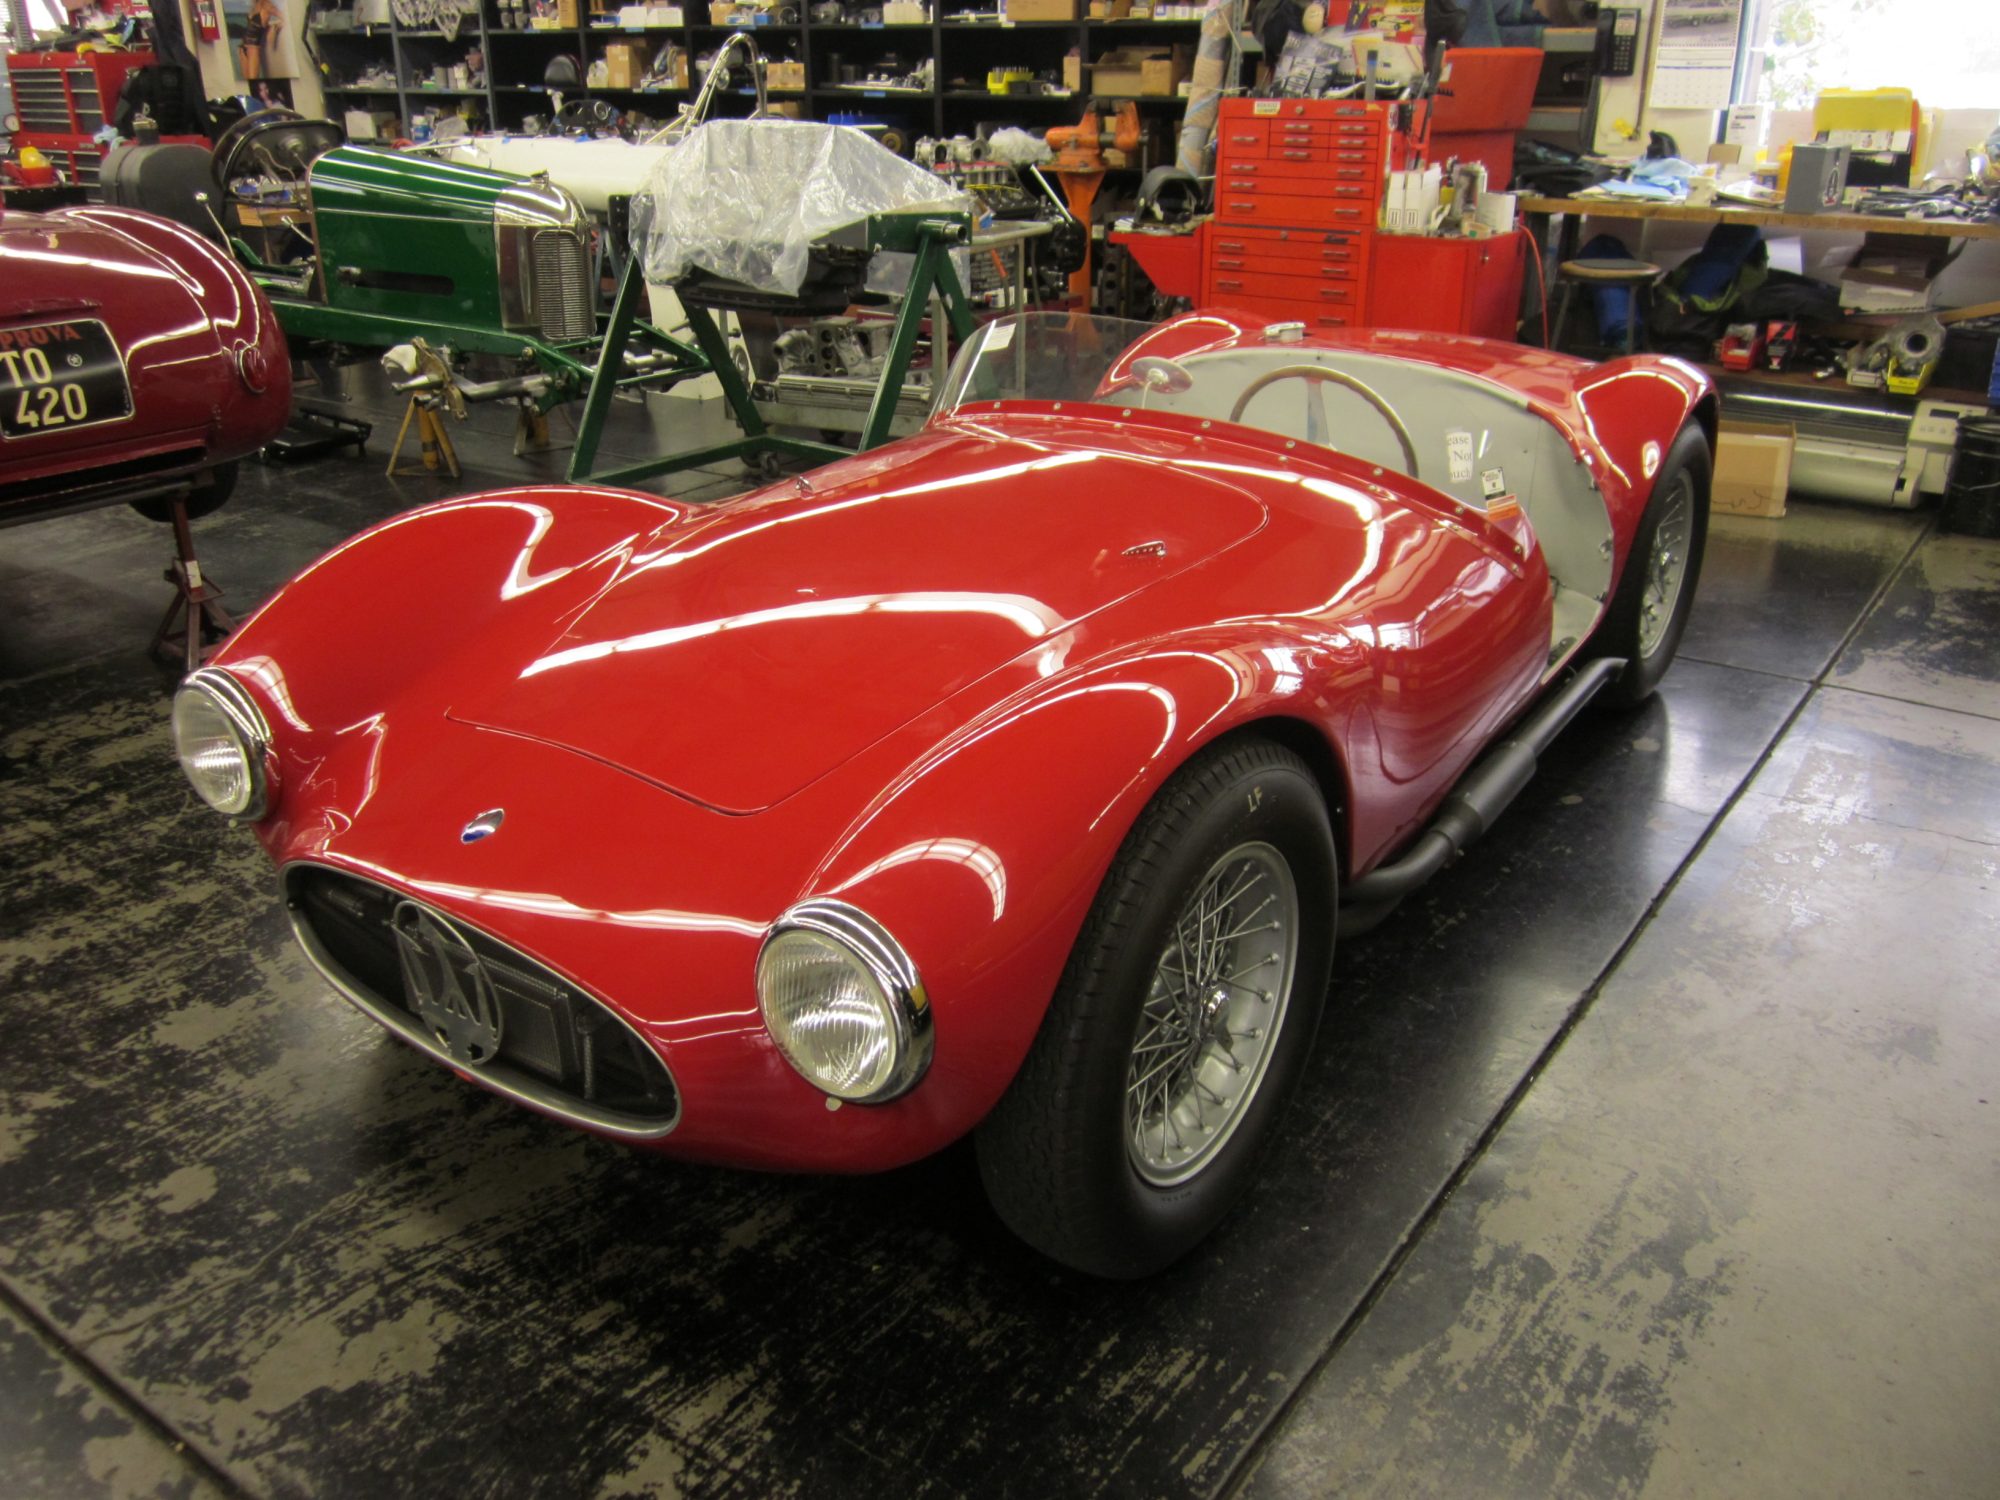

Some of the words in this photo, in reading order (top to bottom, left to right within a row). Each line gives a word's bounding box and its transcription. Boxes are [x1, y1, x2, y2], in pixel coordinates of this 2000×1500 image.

[0, 325, 82, 351] PROVA
[0, 348, 53, 388] TO
[16, 383, 88, 427] 420
